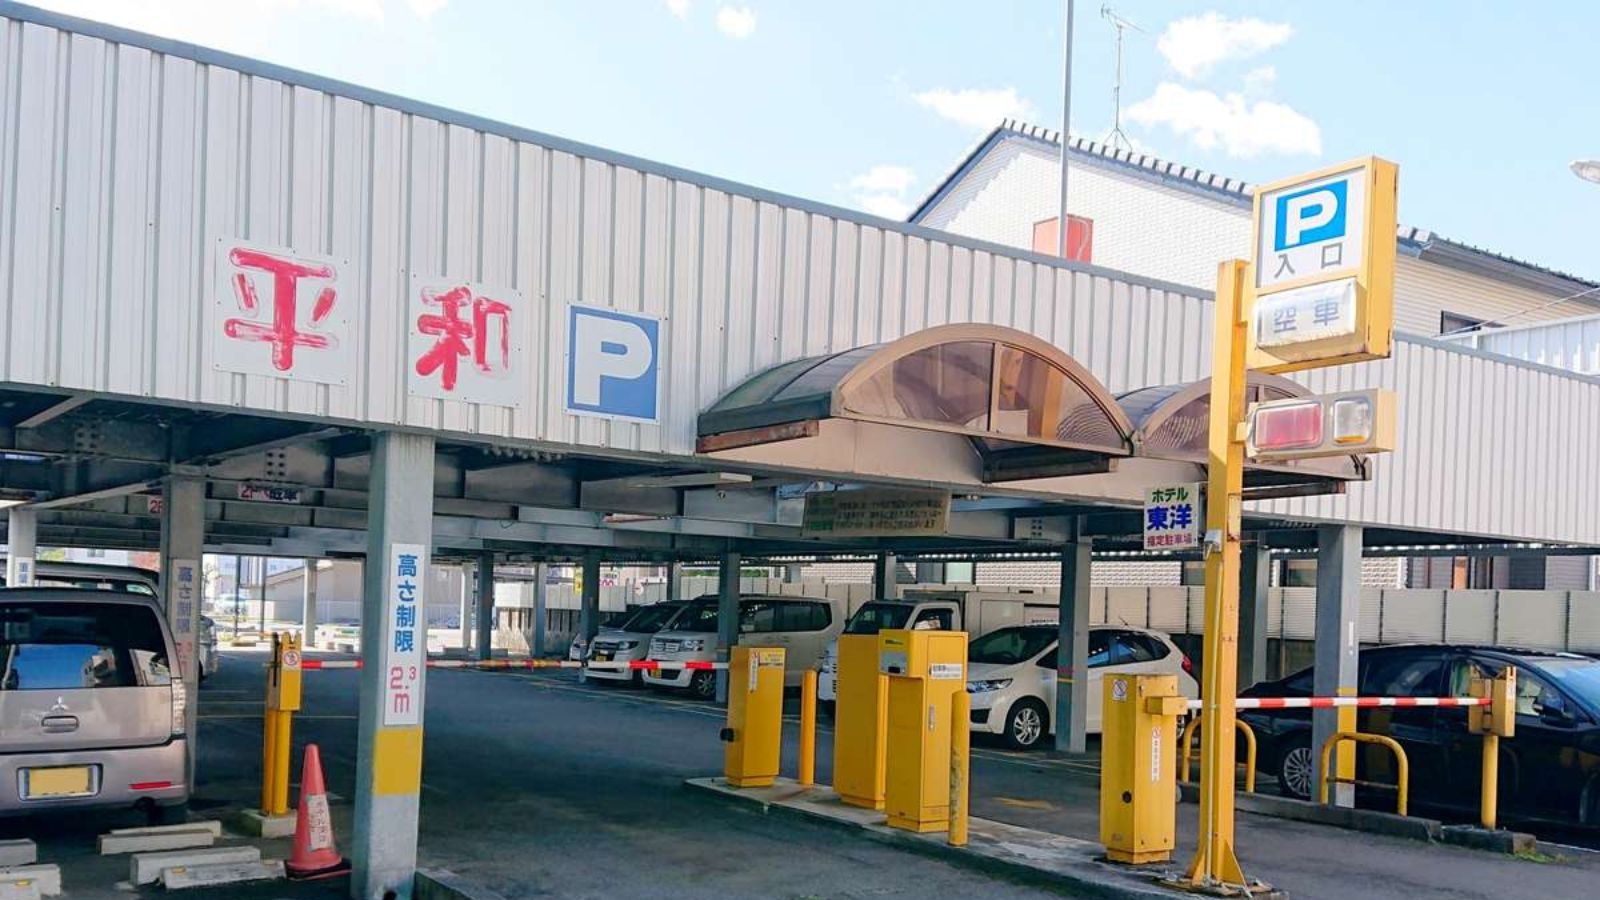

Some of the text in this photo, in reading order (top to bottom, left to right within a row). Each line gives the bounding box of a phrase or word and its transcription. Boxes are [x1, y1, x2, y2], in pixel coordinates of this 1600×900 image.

[1285, 190, 1339, 247] P
[1274, 242, 1343, 279] 入口
[224, 247, 511, 391] 平和
[1273, 298, 1340, 333] 空車
[573, 313, 653, 407] P
[1147, 504, 1192, 530] 東洋
[1152, 487, 1189, 503] ホテル
[394, 554, 418, 652] 高さ制限
